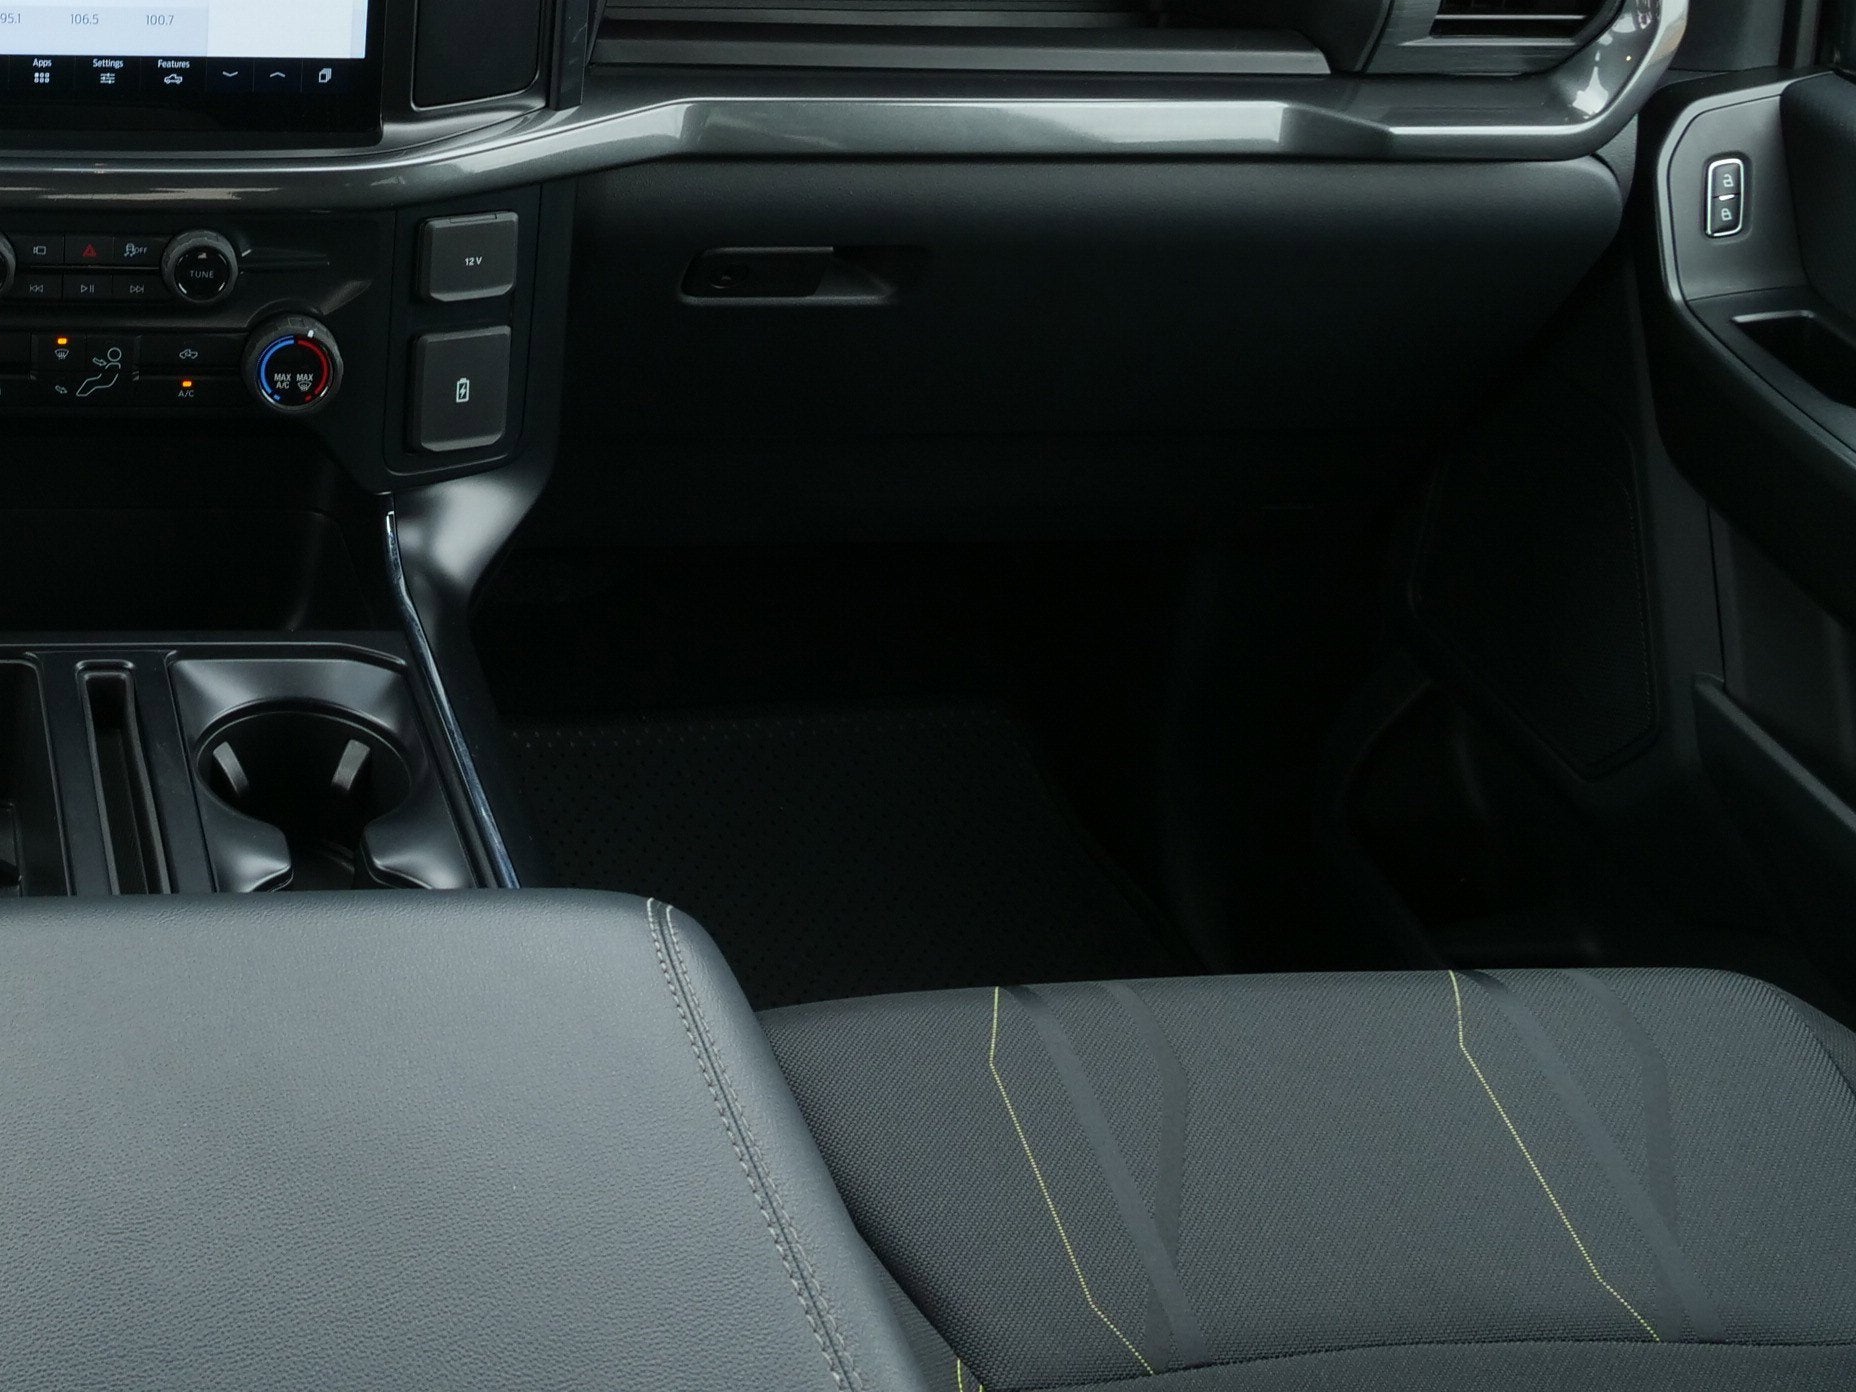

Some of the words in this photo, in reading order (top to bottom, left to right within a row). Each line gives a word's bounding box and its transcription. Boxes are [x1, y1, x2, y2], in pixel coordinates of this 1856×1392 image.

[0, 12, 22, 25] 95.1
[69, 13, 100, 26] 106.5
[145, 14, 175, 27] 100.7
[33, 58, 52, 69] Apps
[93, 58, 124, 70] Settings
[157, 59, 190, 69] Features
[189, 270, 215, 279] TUNE
[273, 373, 292, 382] MAX
[296, 373, 314, 382] MAX
[178, 389, 194, 398] A/C
